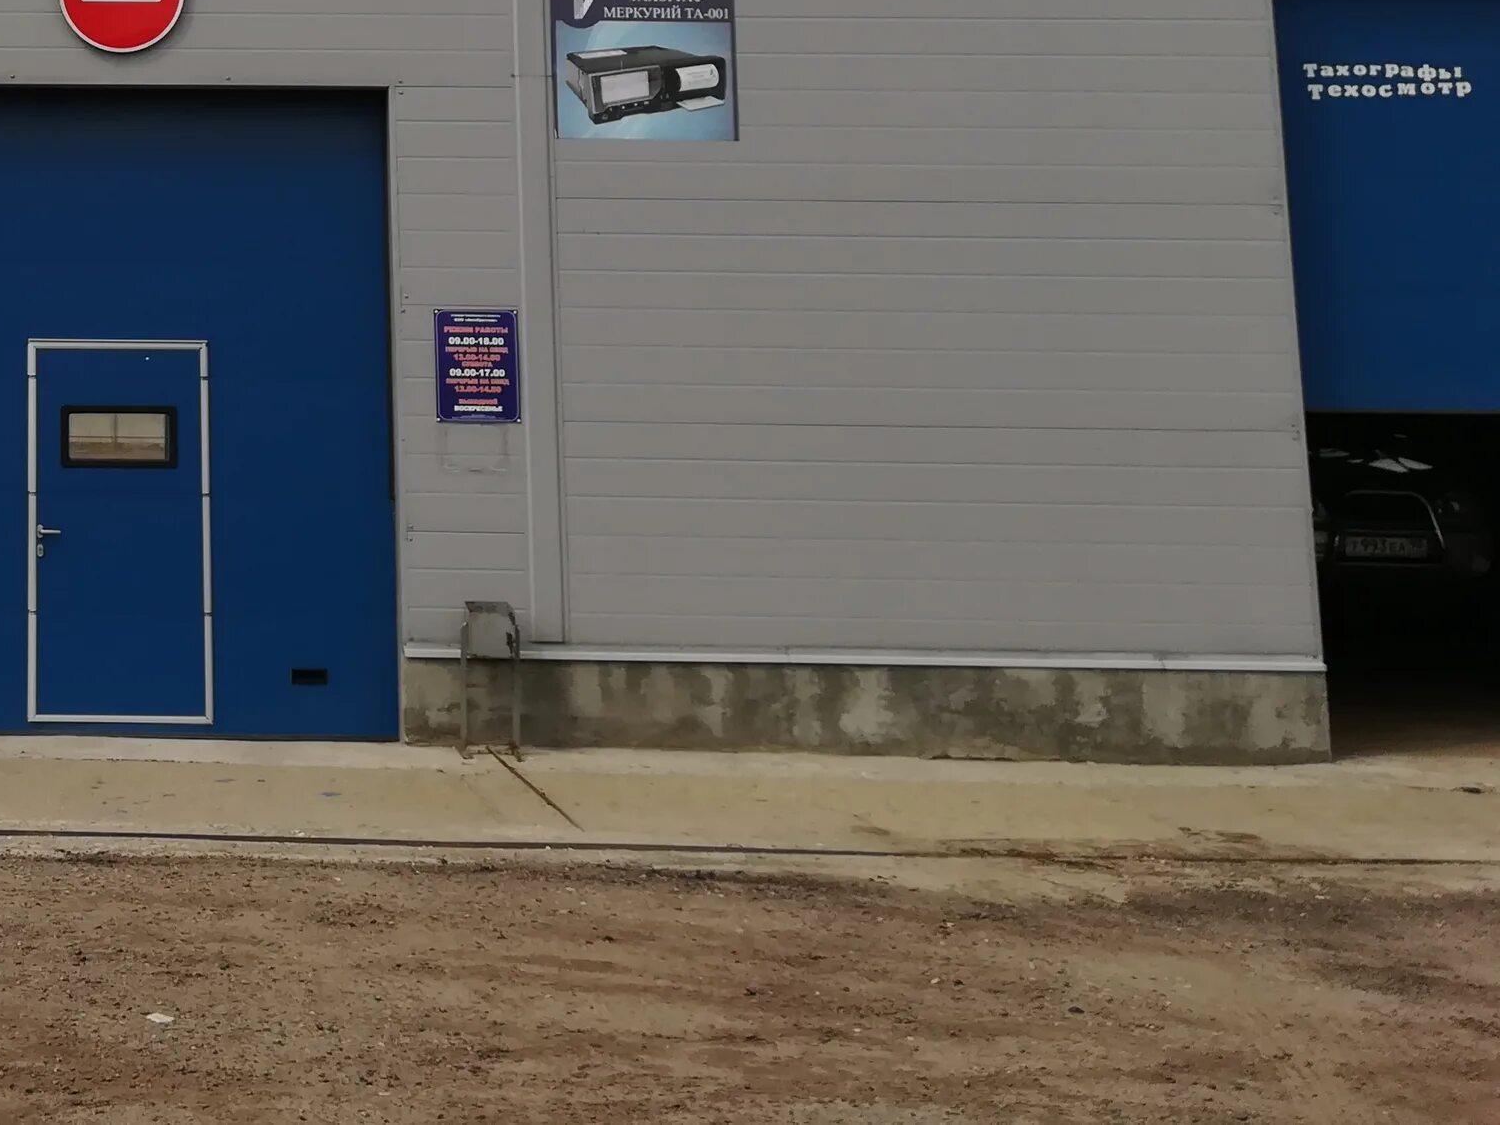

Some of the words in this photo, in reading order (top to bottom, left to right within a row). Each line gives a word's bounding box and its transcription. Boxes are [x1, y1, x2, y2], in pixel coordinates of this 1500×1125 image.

[603, 5, 681, 19] МЕРКУРИЙ
[685, 7, 729, 20] ТА-001
[1307, 81, 1472, 100] Техосмотр
[448, 337, 504, 345] 09.00-18.00
[449, 368, 506, 377] 09.00-17.00
